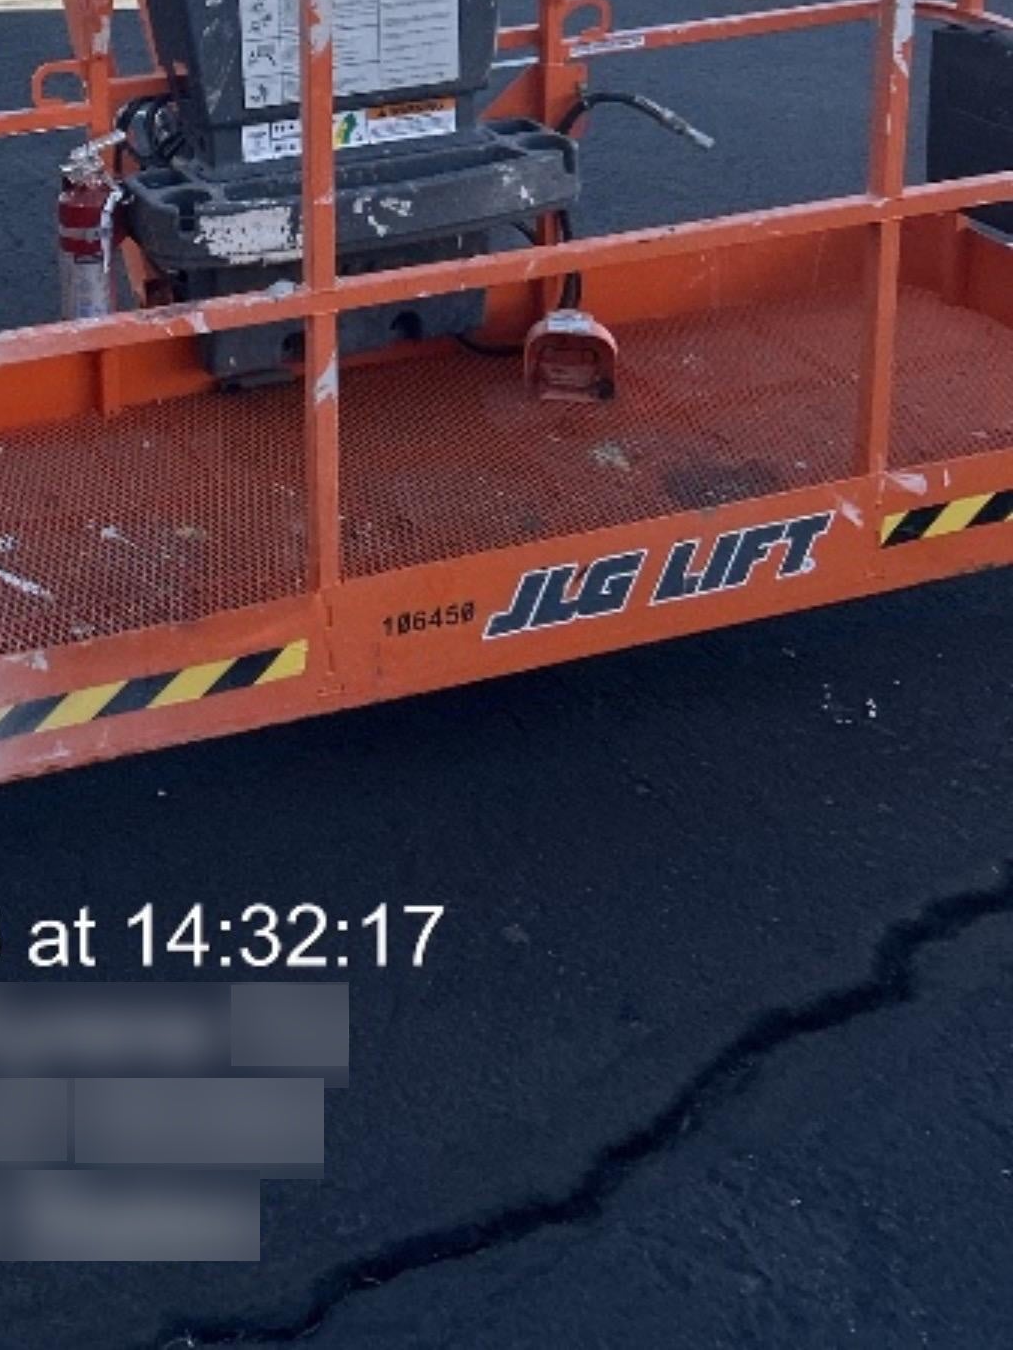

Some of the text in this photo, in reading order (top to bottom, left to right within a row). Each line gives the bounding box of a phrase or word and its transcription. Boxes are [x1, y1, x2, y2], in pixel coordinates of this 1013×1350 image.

[482, 510, 836, 640] JLG LIFT
[382, 601, 476, 637] 106450
